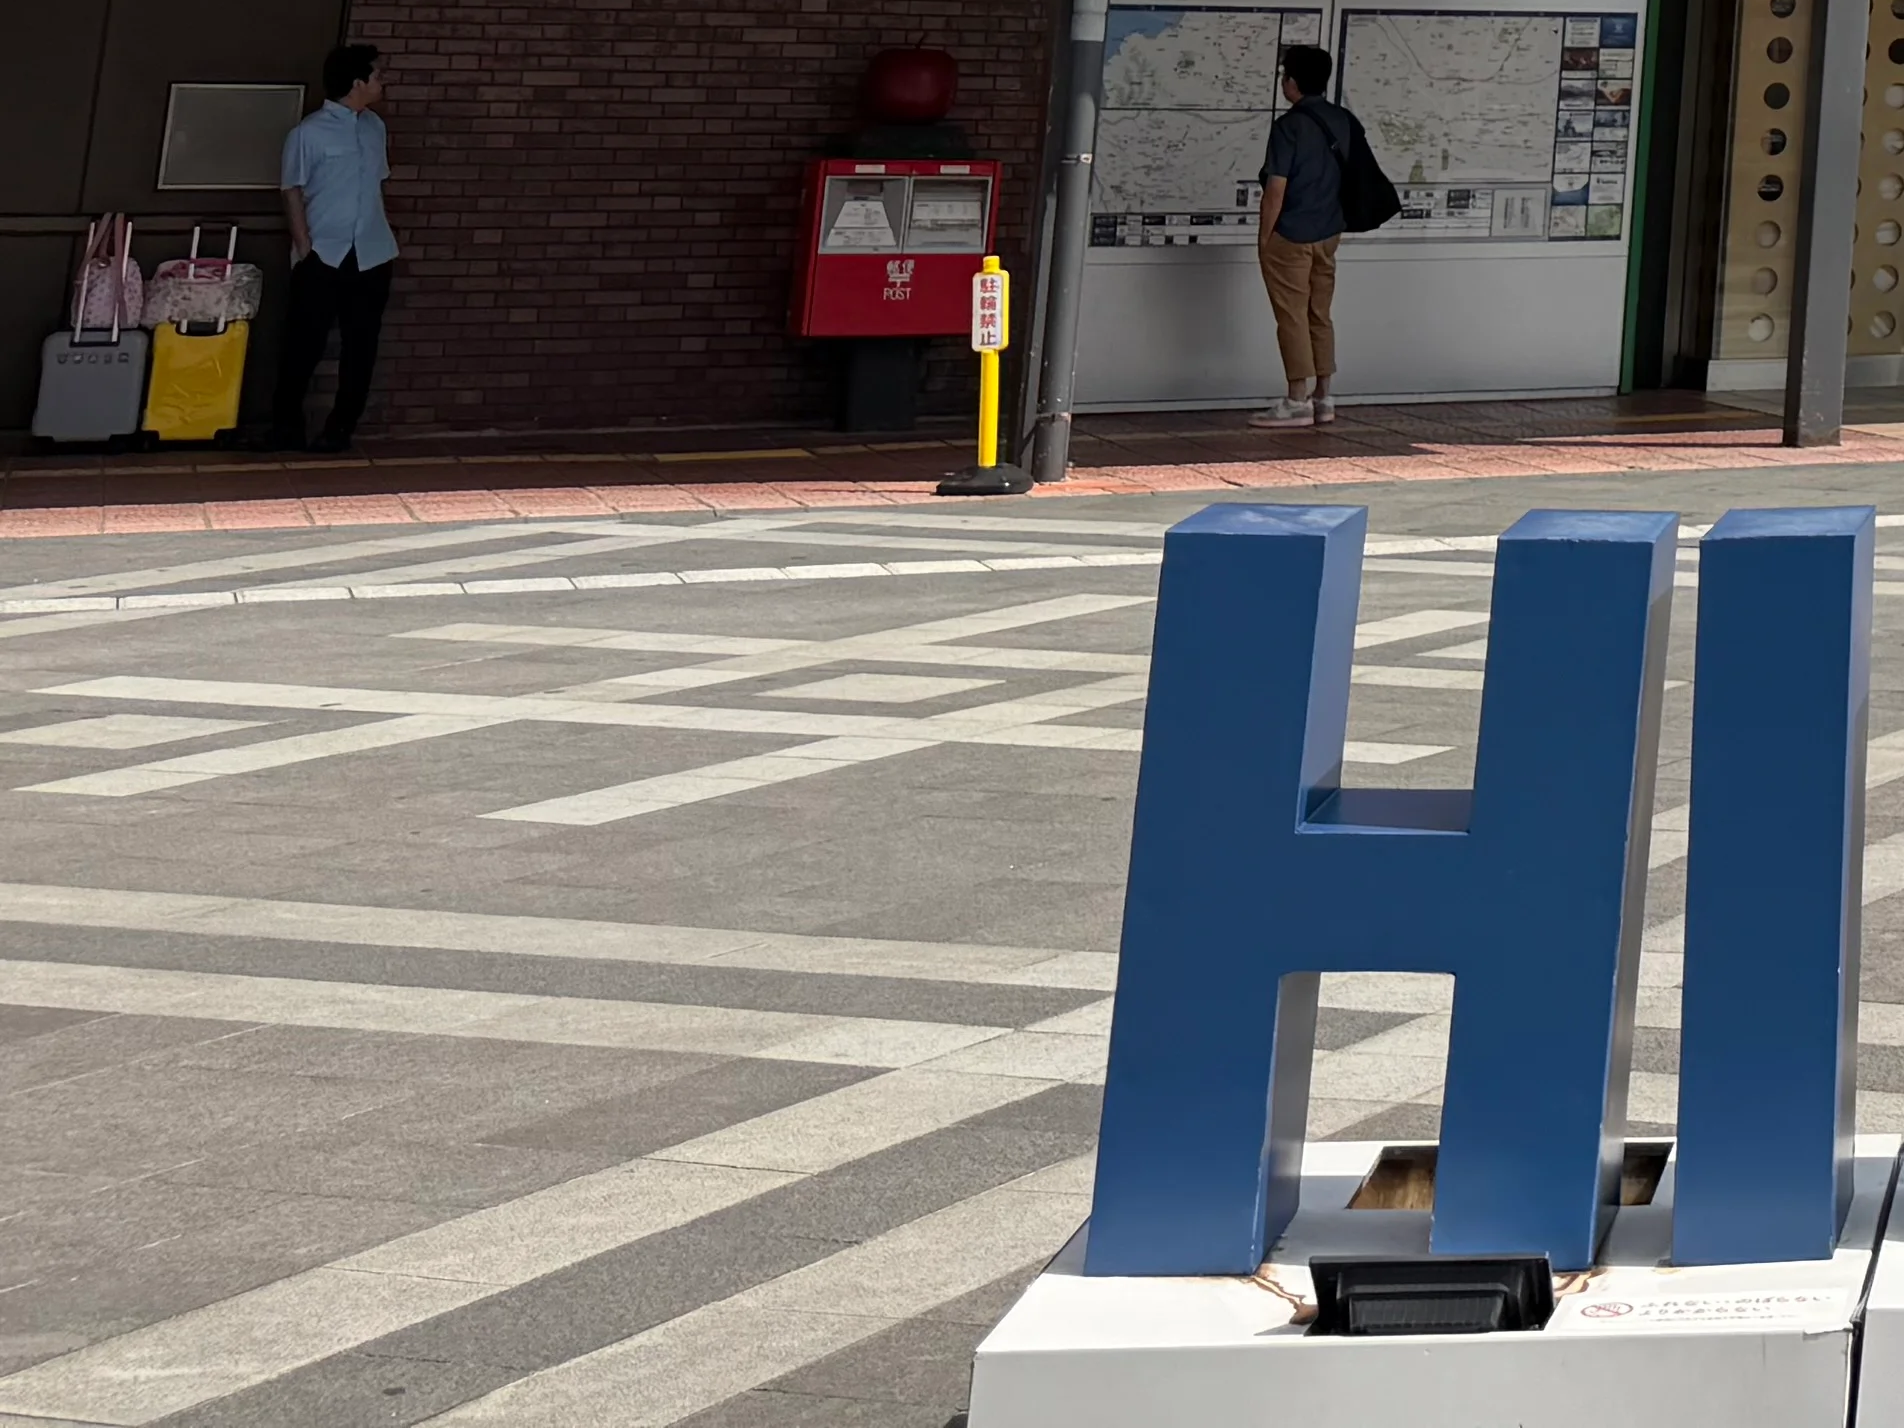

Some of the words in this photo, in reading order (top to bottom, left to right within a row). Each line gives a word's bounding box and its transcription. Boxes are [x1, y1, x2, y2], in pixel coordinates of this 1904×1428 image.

[883, 287, 912, 301] POST
[980, 278, 998, 346] 駐輪禁止
